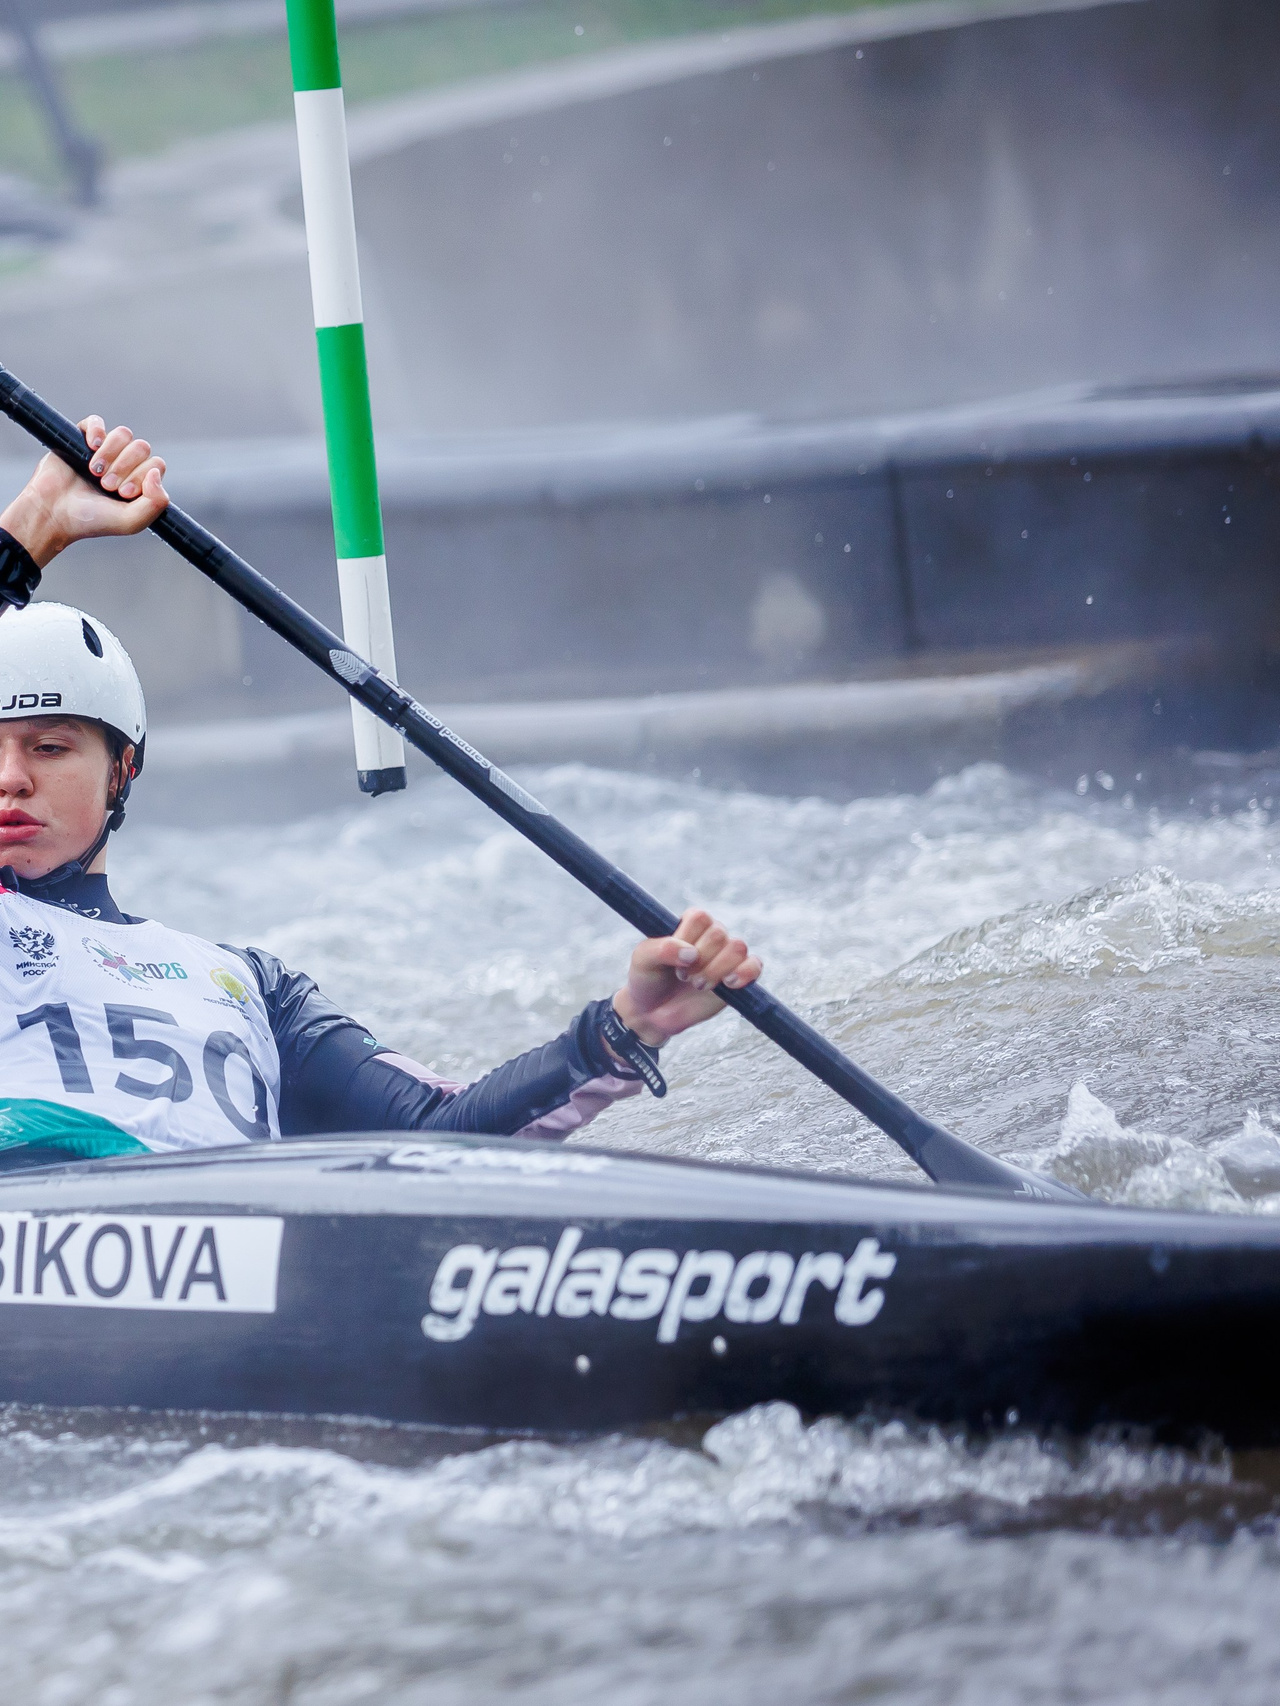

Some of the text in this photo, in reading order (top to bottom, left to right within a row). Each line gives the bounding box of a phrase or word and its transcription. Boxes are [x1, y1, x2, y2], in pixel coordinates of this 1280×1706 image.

[134, 962, 189, 980] 2026
[16, 1001, 271, 1143] 150
[420, 1225, 898, 1344] galasport
